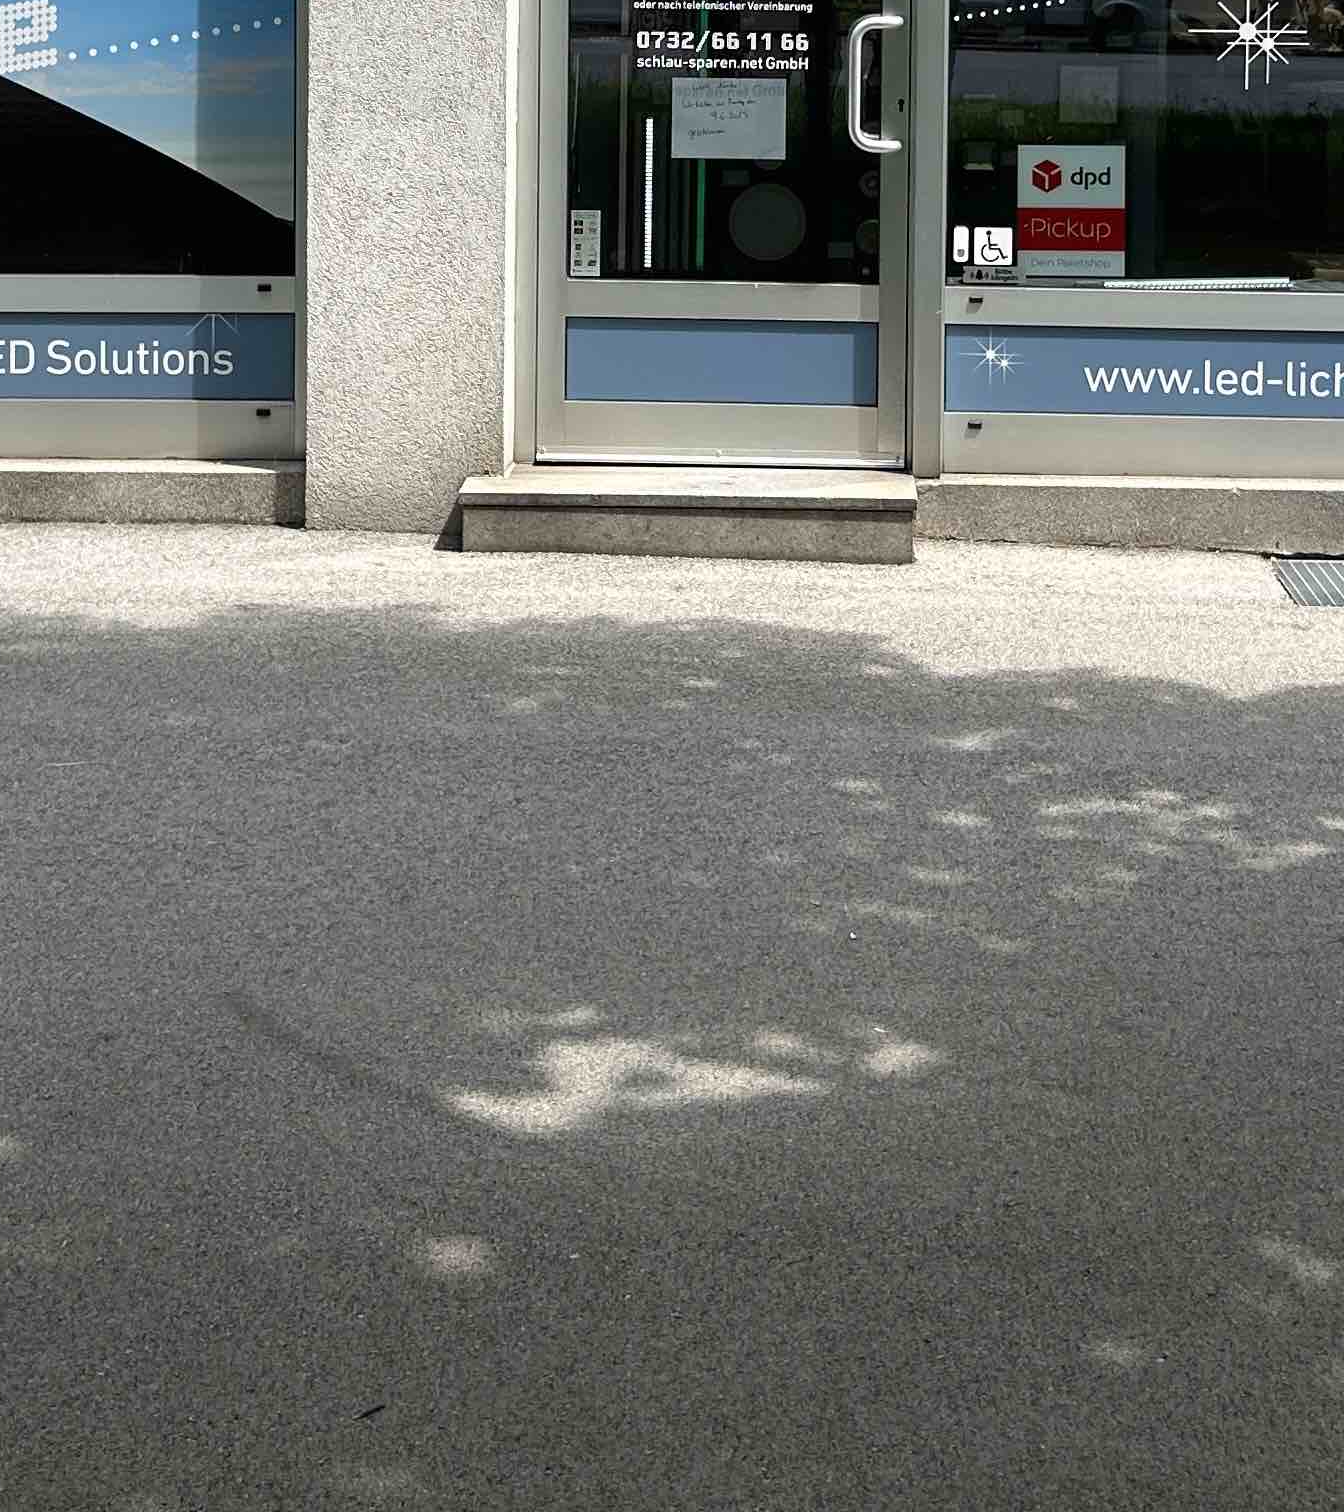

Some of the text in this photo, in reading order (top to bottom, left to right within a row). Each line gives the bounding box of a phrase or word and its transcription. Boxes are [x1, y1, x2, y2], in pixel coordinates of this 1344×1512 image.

[633, 0, 813, 13] oder nach telefonischer Vereinbarung
[636, 30, 809, 53] 0732/66 11 66
[636, 54, 809, 71] schlau-sparen.net GmbH
[1070, 166, 1112, 190] dpd
[1031, 217, 1112, 243] Pickup
[47, 339, 234, 377] Solutions
